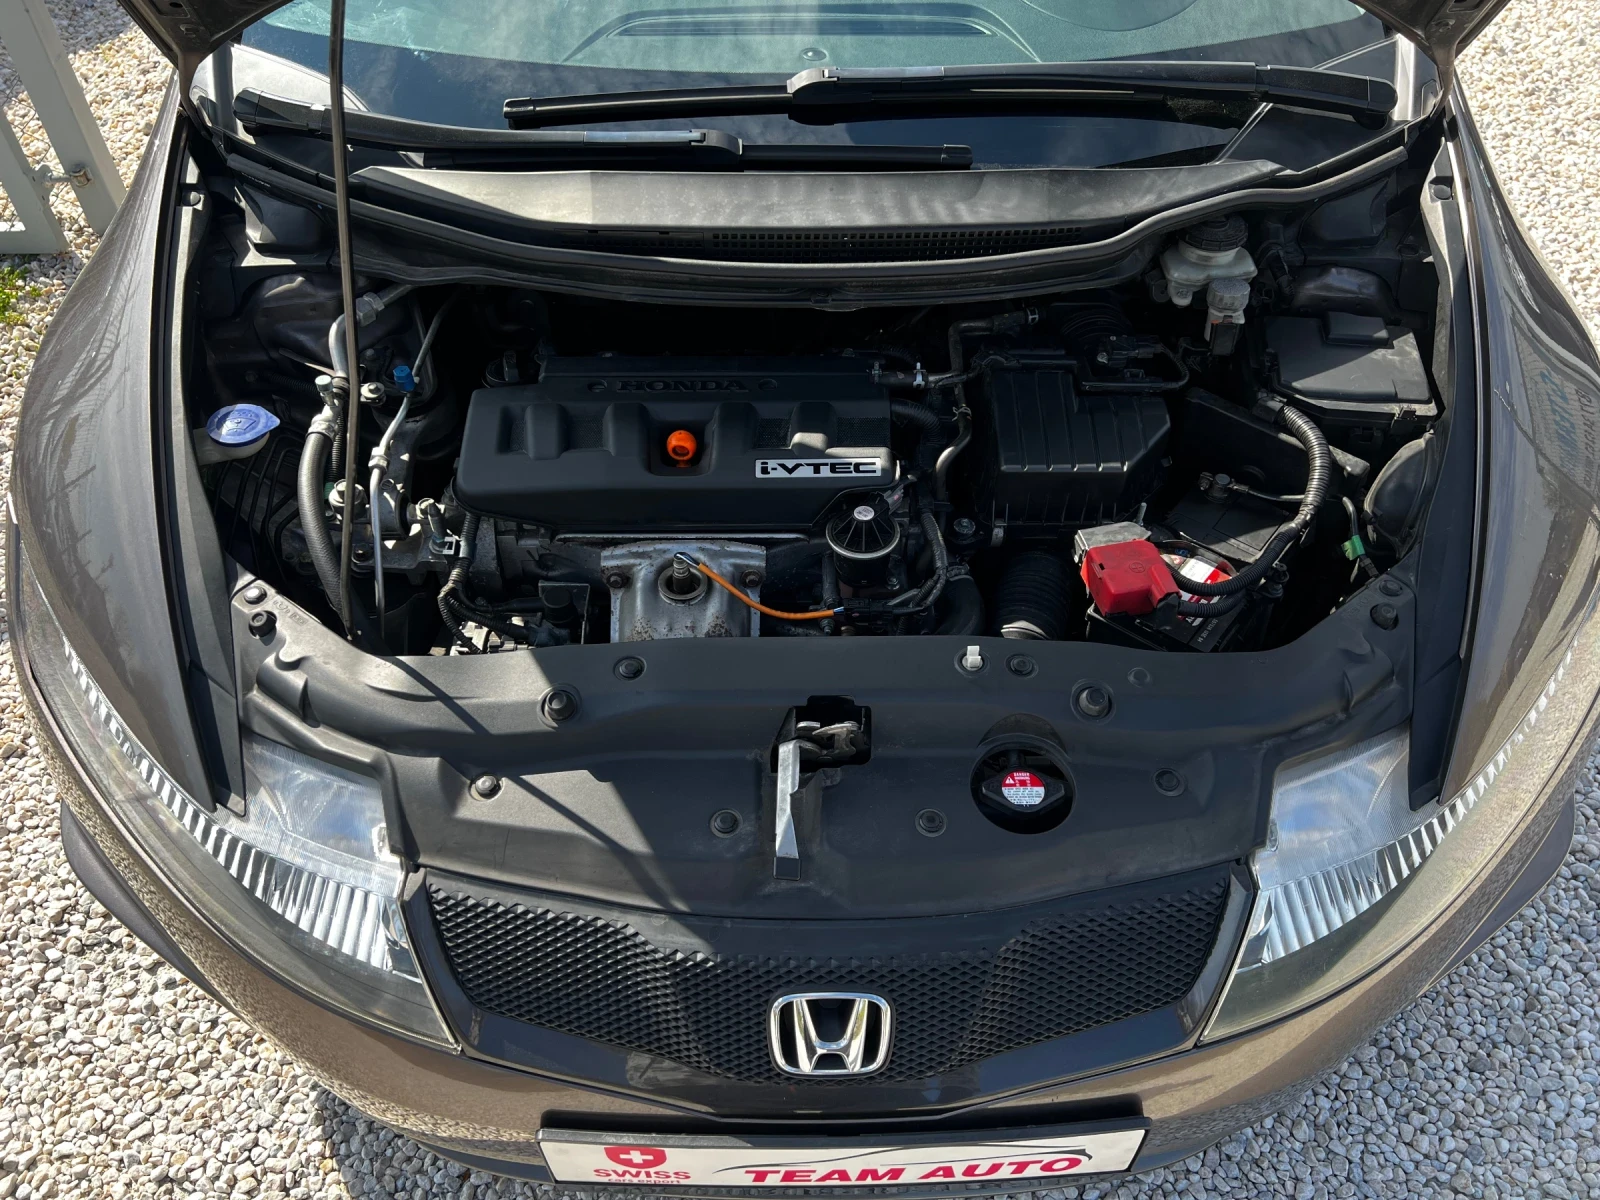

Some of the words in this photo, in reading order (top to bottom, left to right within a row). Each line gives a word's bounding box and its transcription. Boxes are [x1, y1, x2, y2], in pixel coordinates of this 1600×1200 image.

[616, 380, 749, 392] HONDA
[760, 461, 877, 475] i-VTEC
[593, 1168, 692, 1180] SWISS
[745, 1168, 906, 1183] TEAM
[919, 1157, 1083, 1180] AUTO
